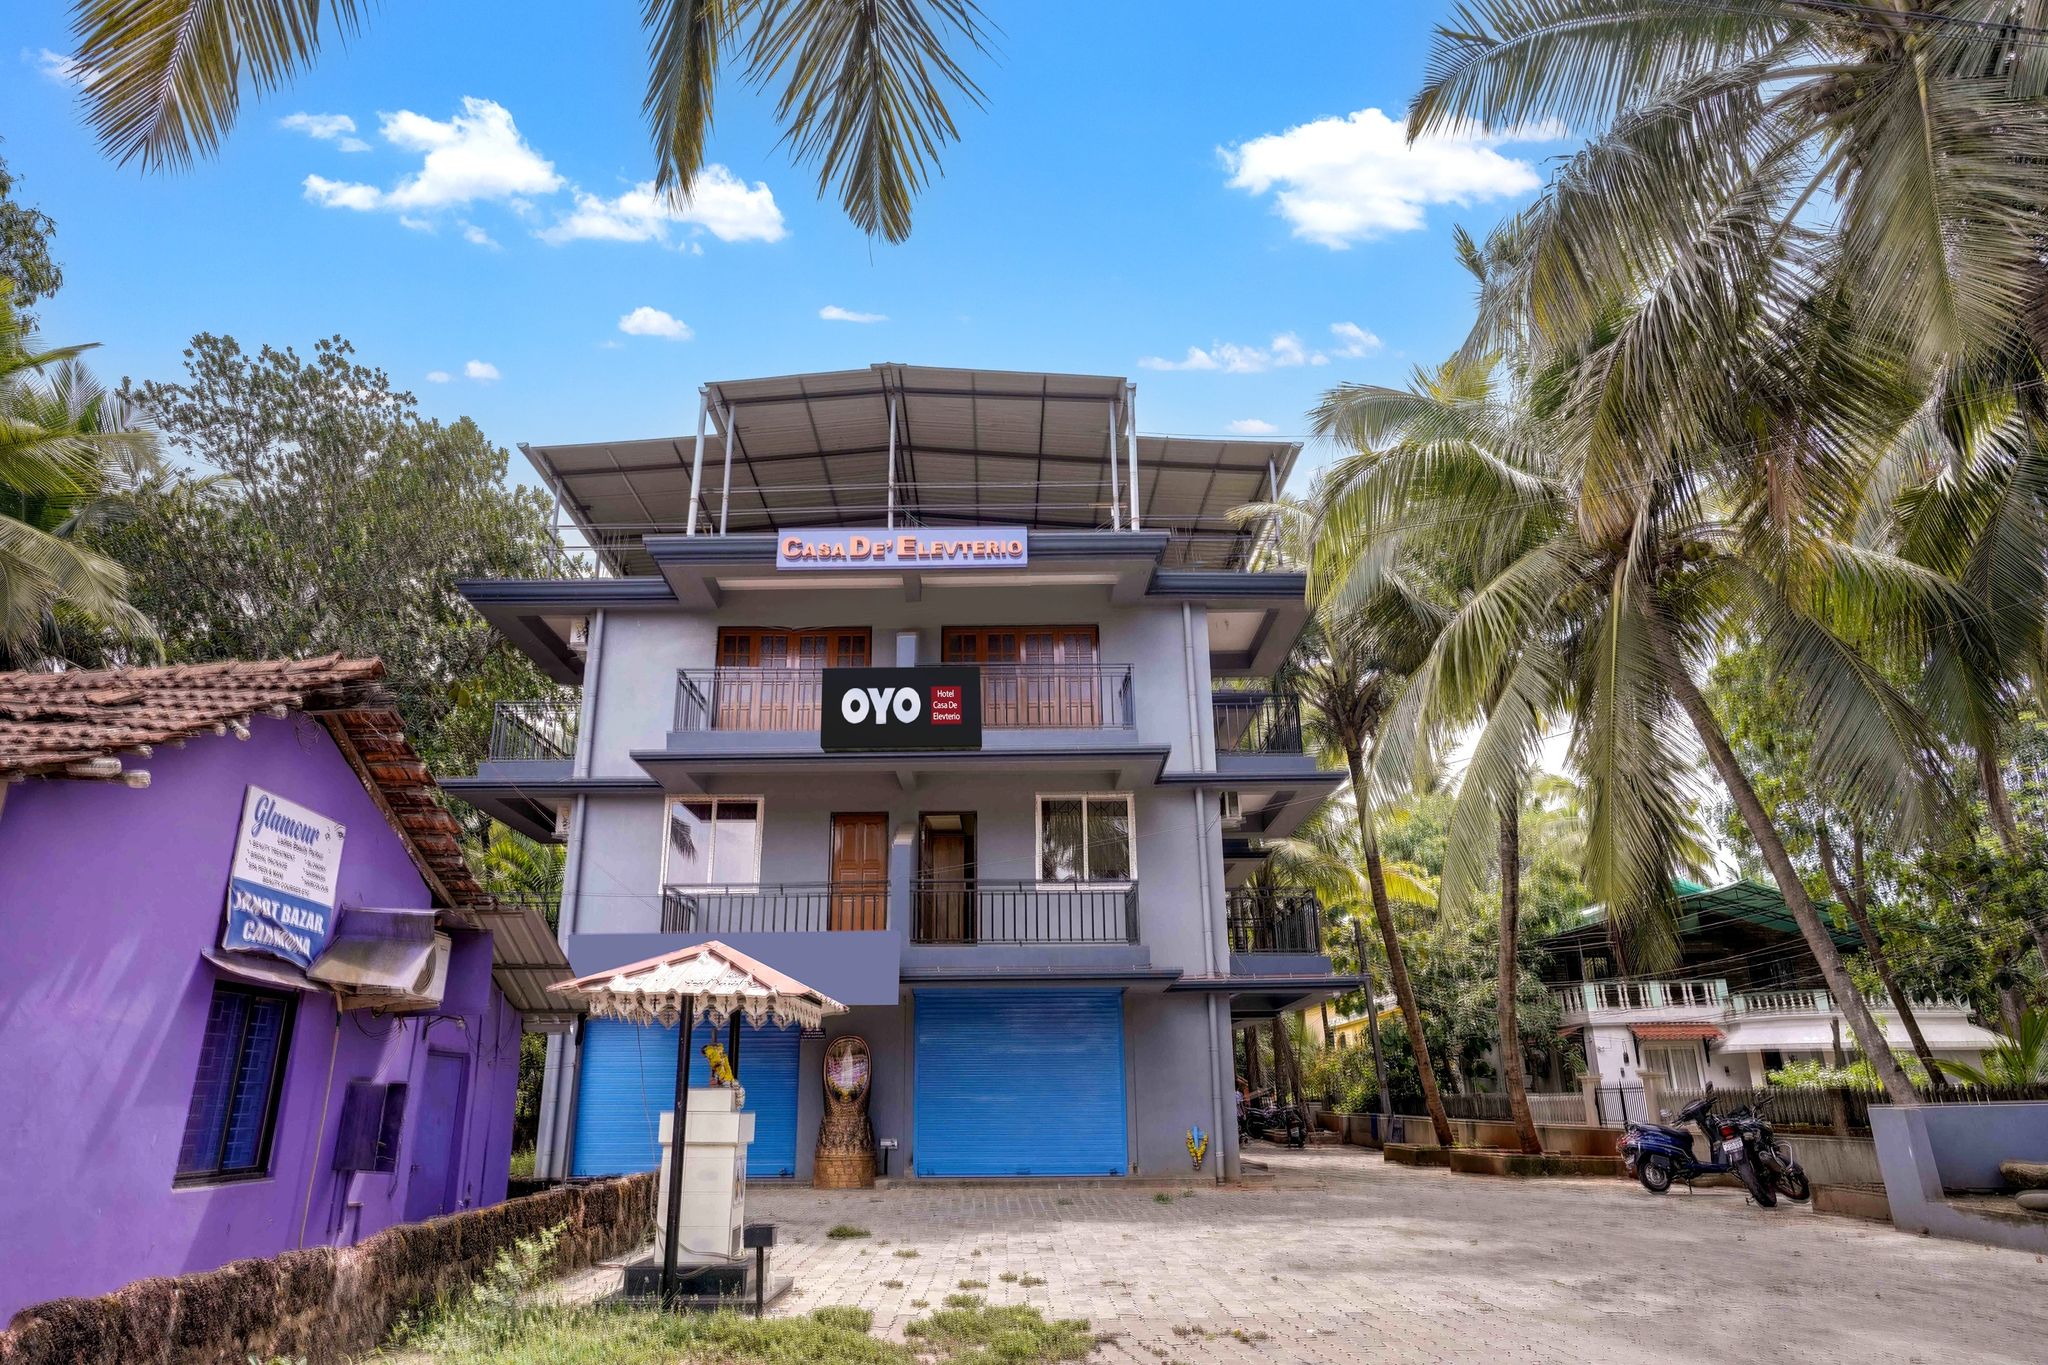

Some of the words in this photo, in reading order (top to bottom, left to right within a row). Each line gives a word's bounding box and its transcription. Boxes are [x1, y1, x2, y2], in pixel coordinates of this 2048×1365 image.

[937, 689, 955, 698] Hotel
[841, 687, 921, 724] OYO
[933, 701, 947, 709] Casa
[948, 701, 958, 709] De
[933, 712, 961, 721] Elevterio
[251, 795, 319, 846] Glamour
